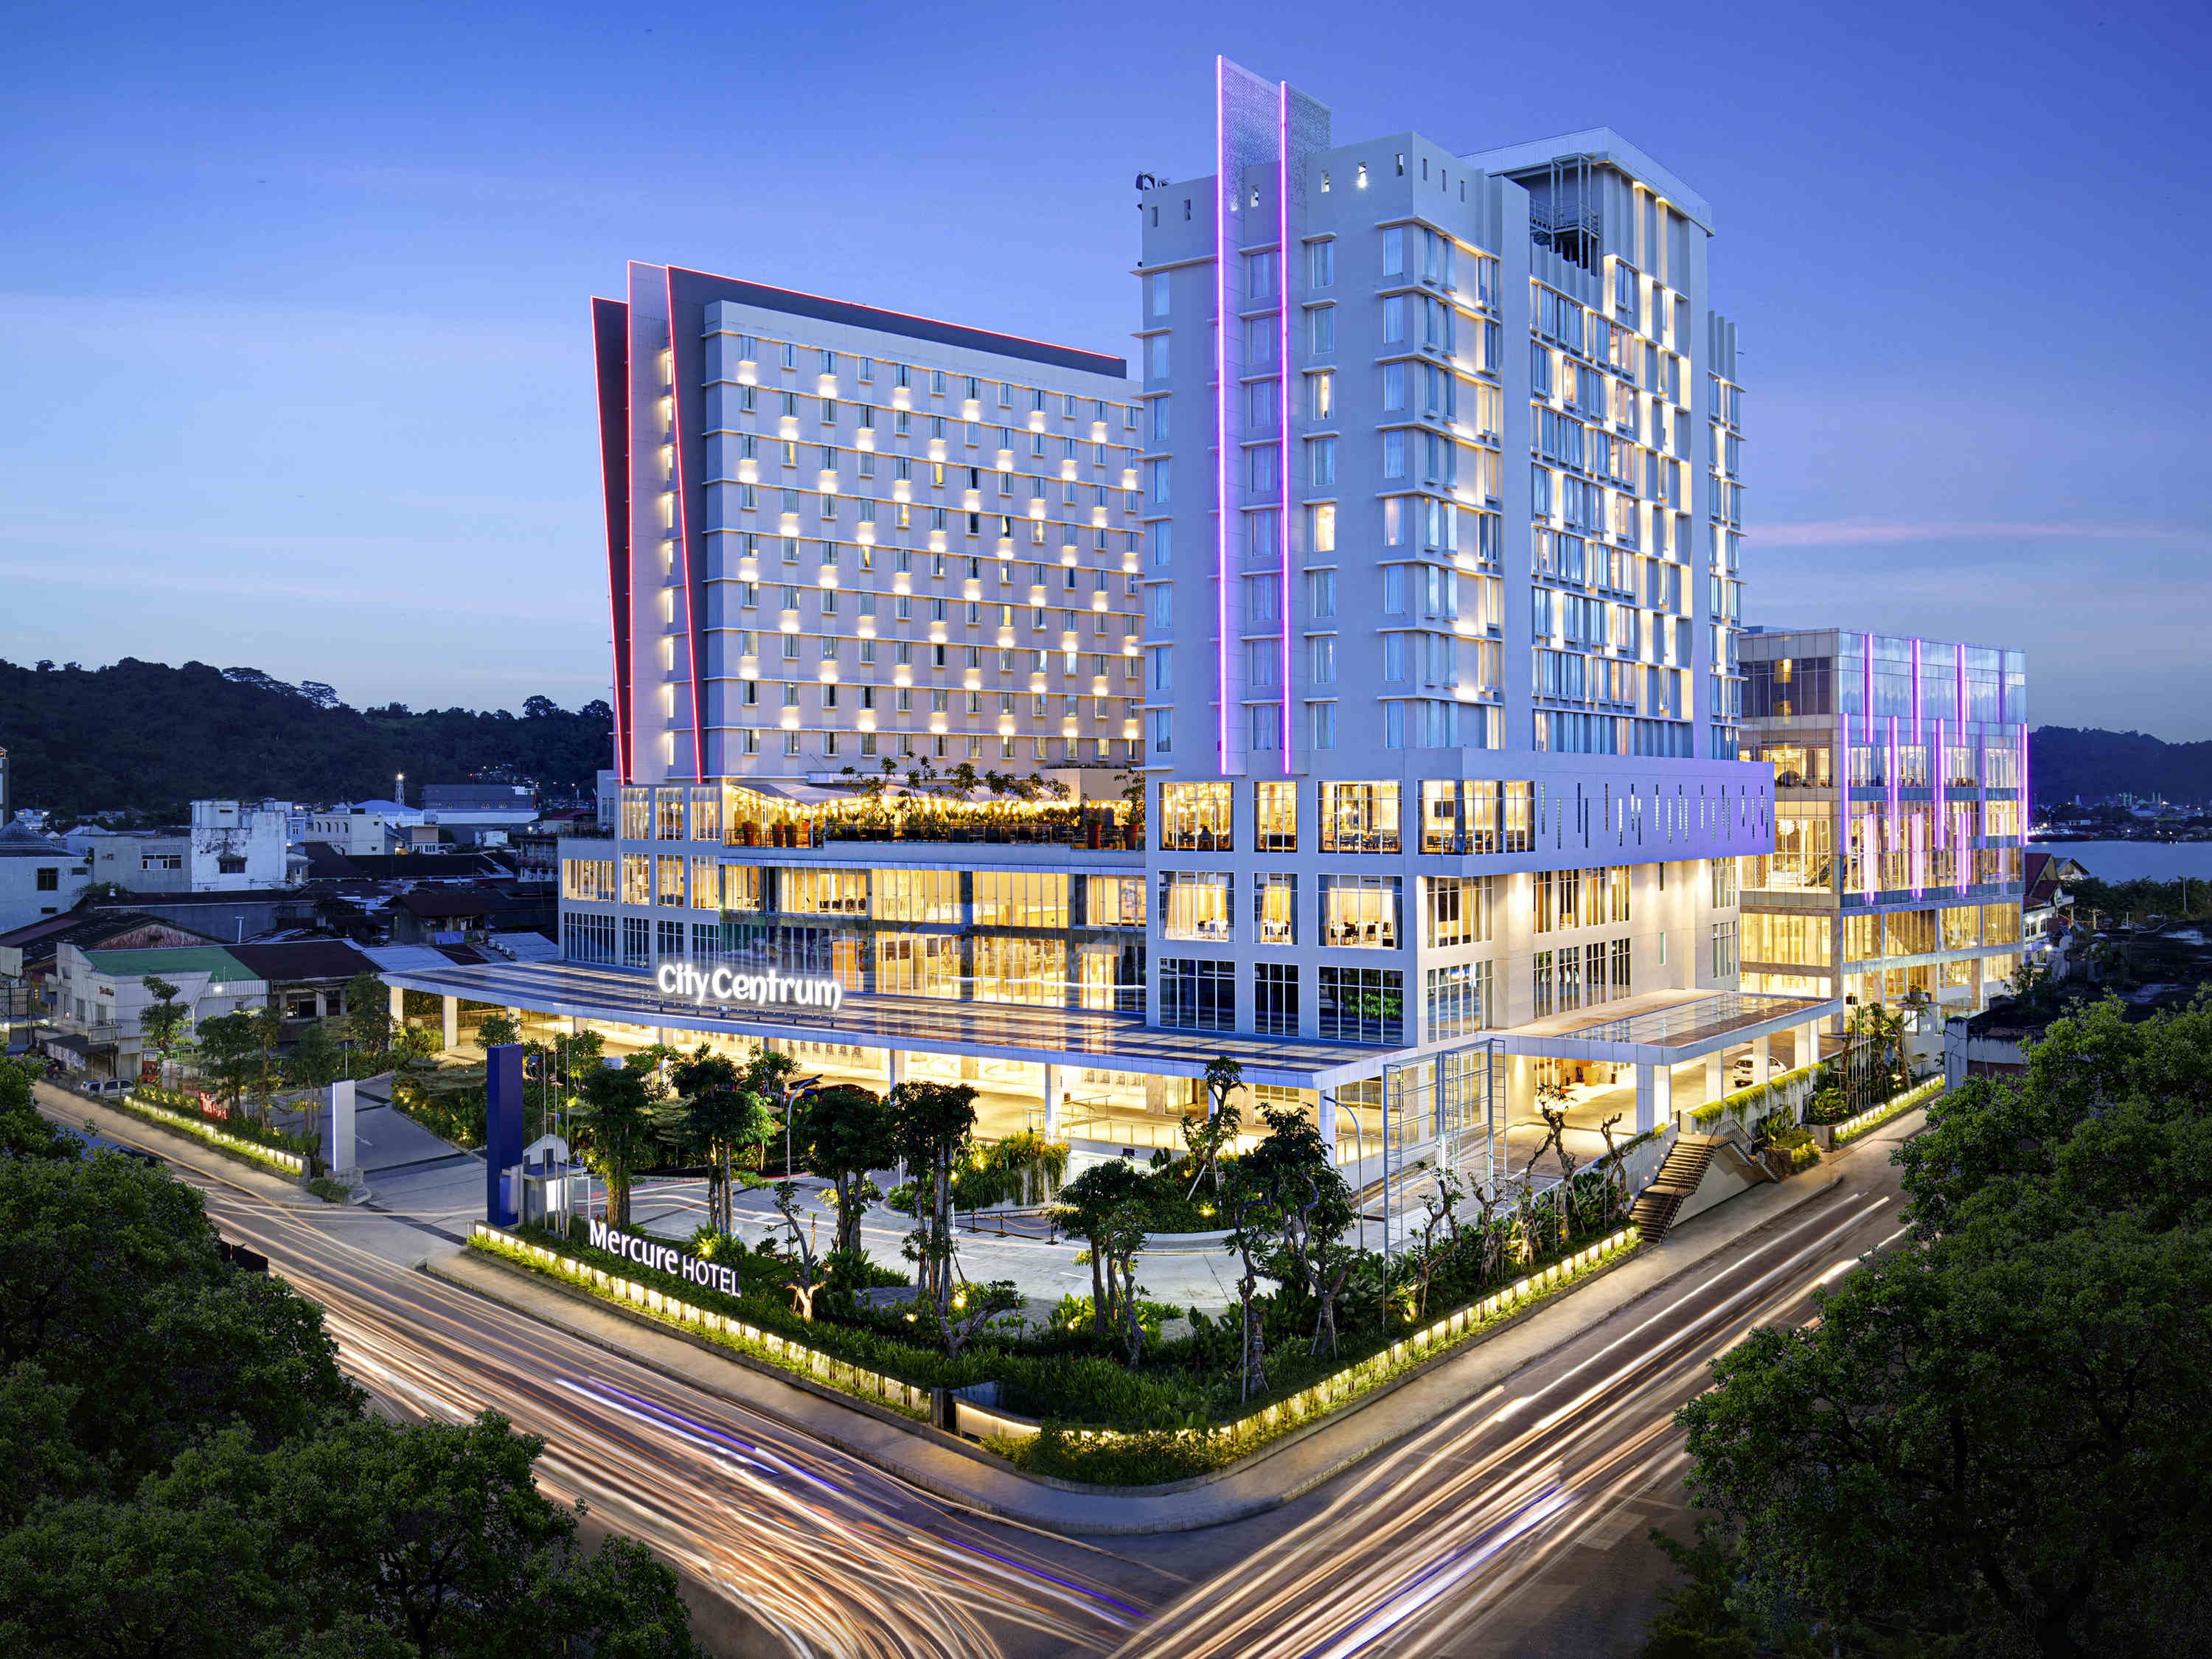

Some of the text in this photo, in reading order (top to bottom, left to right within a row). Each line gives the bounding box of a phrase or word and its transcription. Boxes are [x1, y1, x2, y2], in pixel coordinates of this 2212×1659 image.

[658, 963, 842, 1010] City Centrum
[590, 1219, 740, 1298] Mercure HOTEL
